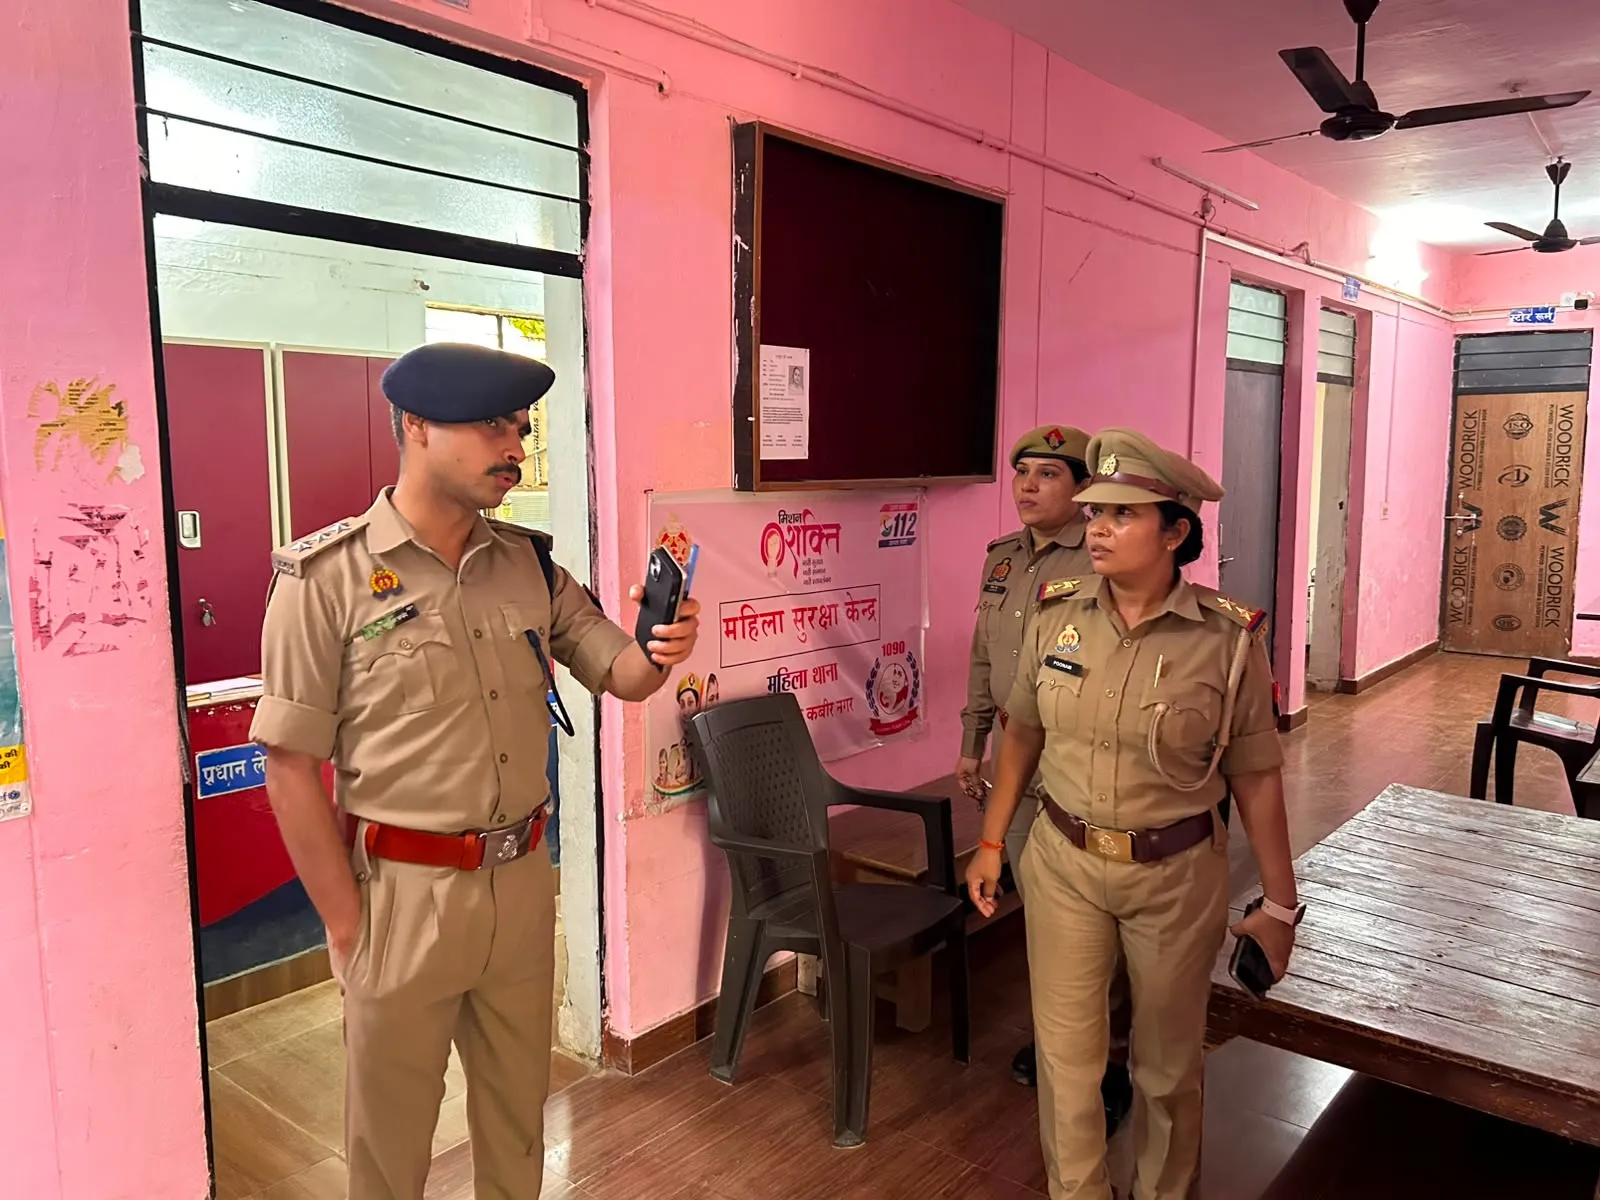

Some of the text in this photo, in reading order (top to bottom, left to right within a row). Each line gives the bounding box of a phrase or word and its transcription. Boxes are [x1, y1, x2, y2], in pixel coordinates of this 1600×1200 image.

[1508, 421, 1530, 430] ISO
[1458, 410, 1478, 490] WOODRICK
[1554, 404, 1574, 488] WOODRICK
[778, 509, 802, 524] मिशन
[893, 512, 918, 537] 112
[785, 508, 842, 579] शक्ति
[1450, 546, 1469, 622] WOODRICK
[1544, 546, 1565, 628] WOODRICK
[722, 591, 877, 643] महिला सुरक्षा केन्द्र
[881, 641, 905, 656] 1090
[766, 662, 839, 693] महिला थाना
[806, 697, 854, 721] कबीर नगर
[201, 750, 268, 786] प्रधान ले
